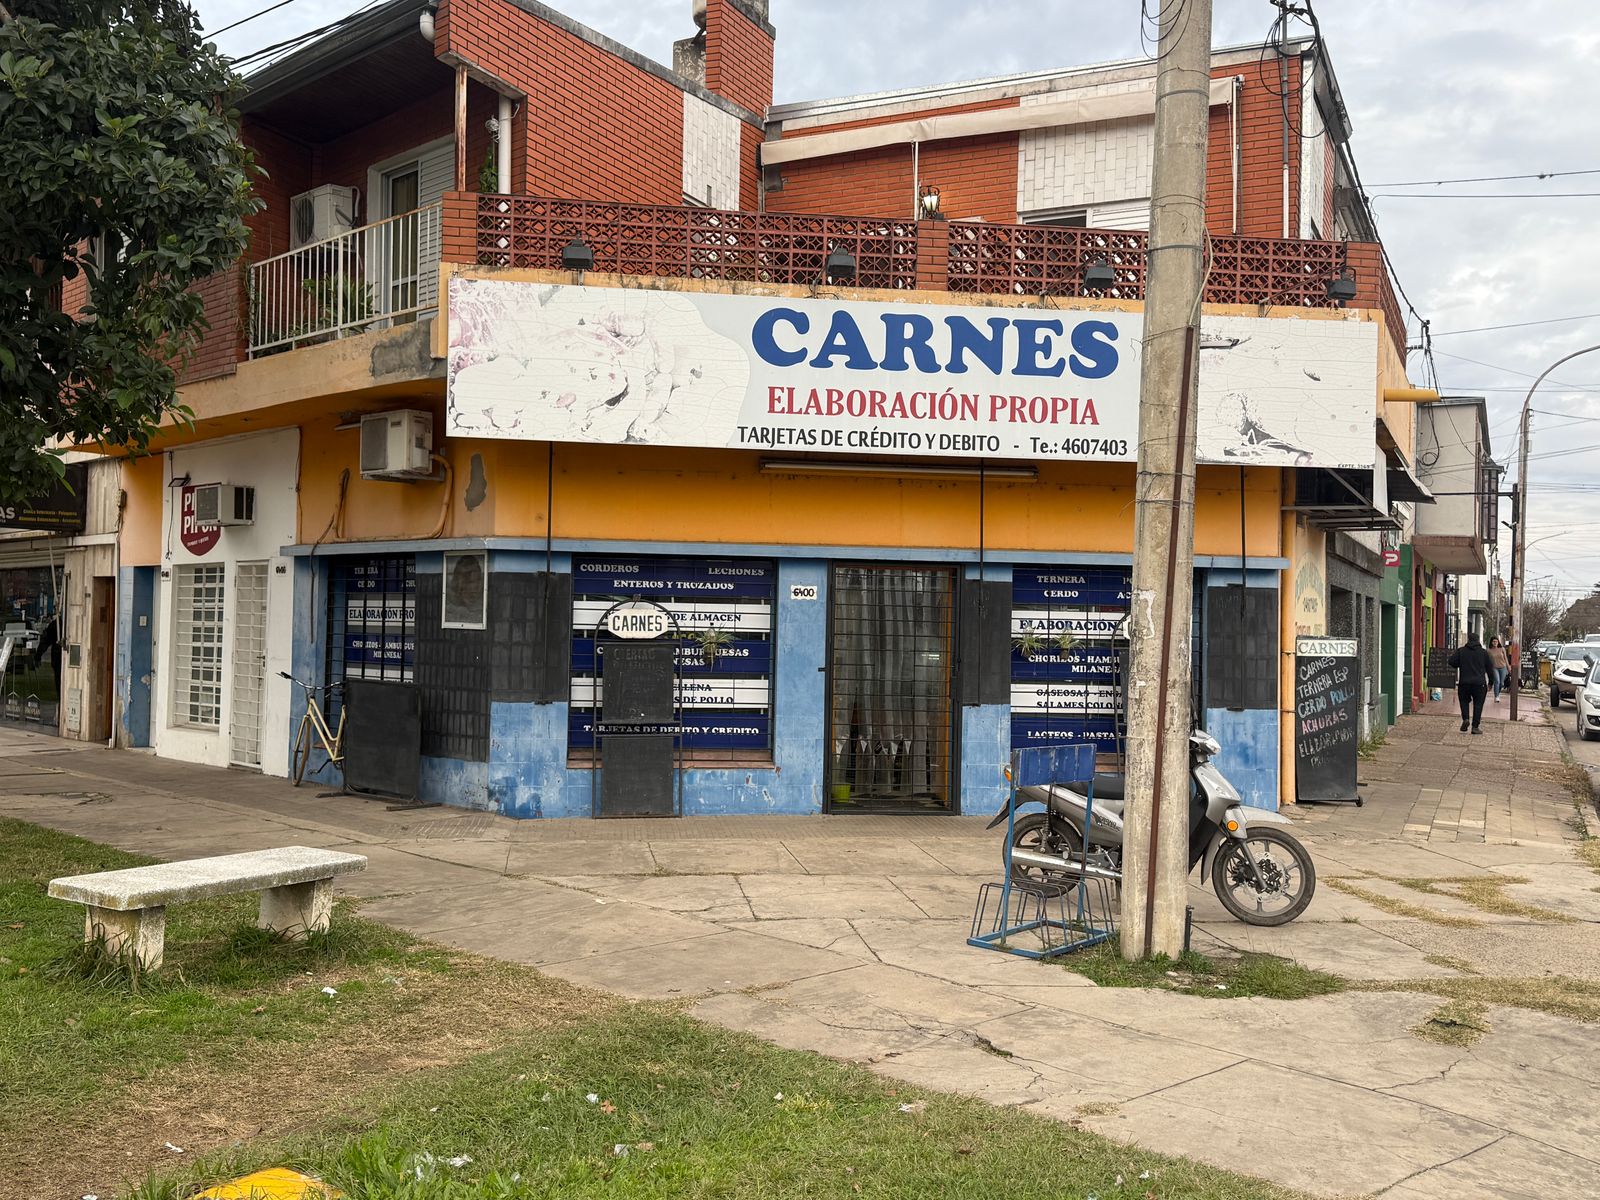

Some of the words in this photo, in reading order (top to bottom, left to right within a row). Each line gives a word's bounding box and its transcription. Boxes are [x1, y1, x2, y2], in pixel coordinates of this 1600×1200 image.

[752, 307, 1119, 379] CARNES
[767, 386, 979, 421] ELABORACIÓN
[989, 395, 1100, 426] PROPIA
[737, 426, 817, 448] TARJETAS
[821, 429, 843, 447] DE
[847, 426, 921, 450] CRÉDITO
[925, 433, 936, 449] Y
[940, 434, 1000, 452] DEBITO
[1030, 437, 1059, 454] Te.:
[1061, 438, 1128, 456] 4607403
[354, 566, 379, 575] TERERA
[580, 563, 639, 573] CORDEROS
[708, 567, 765, 577] LECHONES
[357, 580, 376, 588] CEDO
[1036, 575, 1086, 584] TERNERA
[613, 580, 664, 589] ENTEROS
[676, 581, 735, 590] TROZADOS
[1043, 590, 1079, 598] CERDO
[689, 614, 742, 622] ALMACEN
[612, 615, 663, 632] CARNES
[352, 640, 378, 649] CHOIZOS
[1298, 642, 1356, 655] CARNES
[1028, 655, 1080, 663] CHORIOS
[1300, 656, 1336, 681] CARNES
[1297, 674, 1333, 699] TERNERA
[1333, 667, 1349, 684] ESP
[1036, 688, 1090, 697] GASEOSAS
[699, 696, 734, 704] POLLO
[1297, 696, 1327, 718] CERDO
[1301, 708, 1348, 735] ACHURAS
[711, 727, 759, 735] CREDITO
[1027, 731, 1074, 739] LACTEOS
